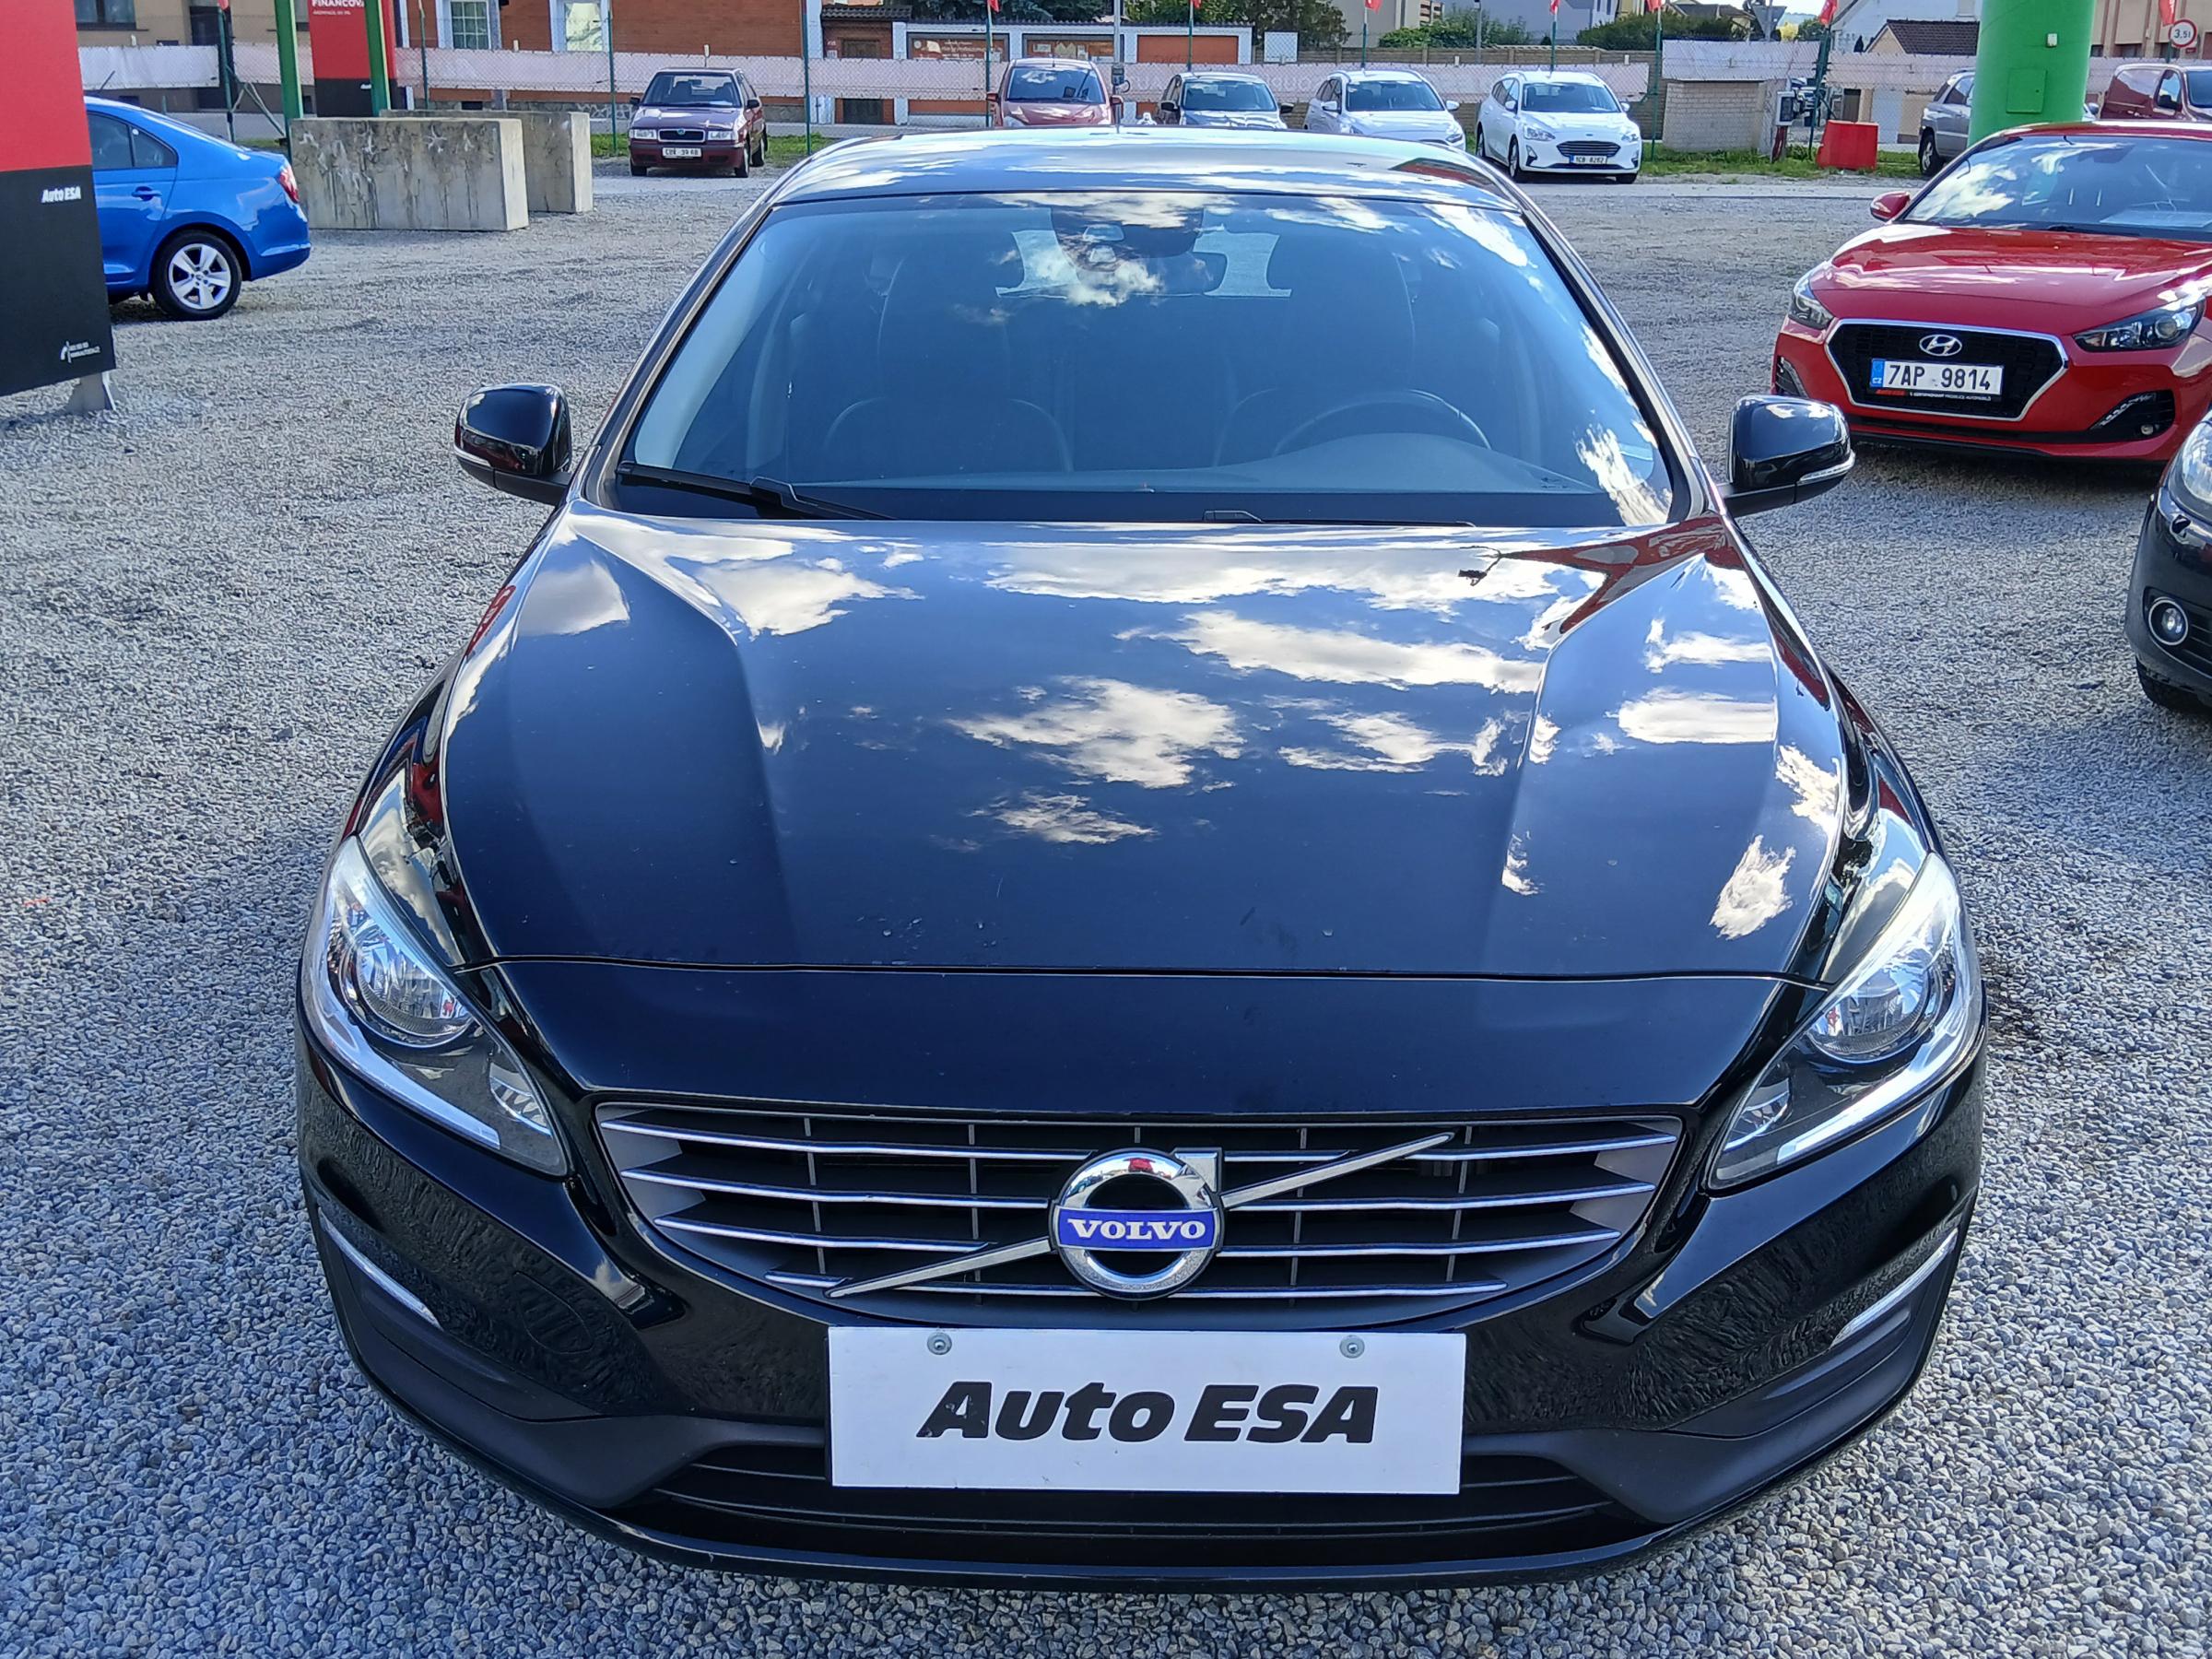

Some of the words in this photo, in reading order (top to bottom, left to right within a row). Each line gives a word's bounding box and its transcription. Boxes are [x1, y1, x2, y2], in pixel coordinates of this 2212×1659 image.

[41, 188, 64, 203] Auto
[65, 186, 81, 201] ESA
[1888, 365, 1925, 386] 7AP
[1940, 368, 1991, 391] 9814
[1067, 1218, 1206, 1240] VOLVO
[916, 1381, 1175, 1442] Auto
[1183, 1384, 1379, 1444] ESA
